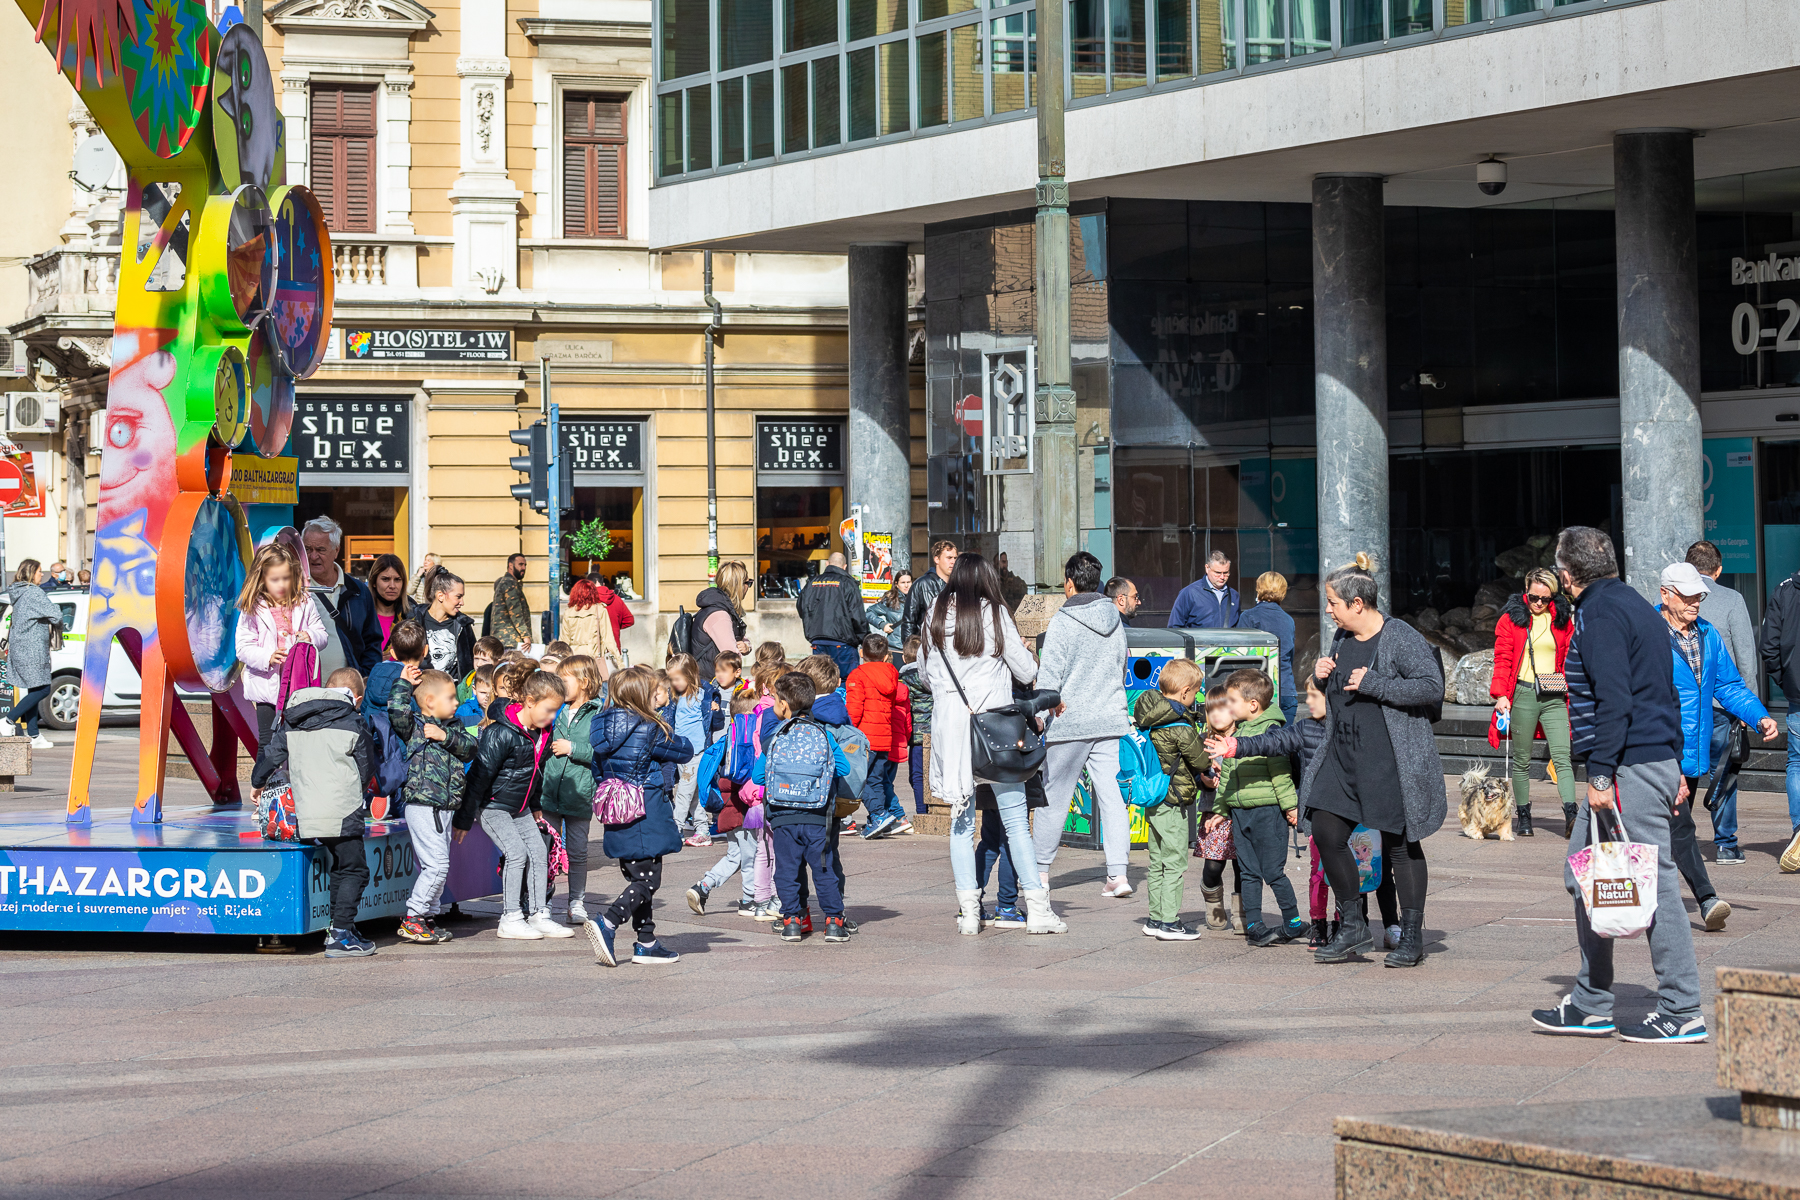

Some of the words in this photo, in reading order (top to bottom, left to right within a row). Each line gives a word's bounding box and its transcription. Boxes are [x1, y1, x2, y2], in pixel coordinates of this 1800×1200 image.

[373, 330, 467, 349] HO(S)TEL
[477, 332, 506, 348] 1W
[244, 469, 295, 484] BALTHAZARGRAD
[863, 531, 892, 544] Plesna
[0, 866, 266, 898] THAZARGRAD
[1595, 882, 1623, 890] Terra
[374, 893, 382, 906] OF
[383, 888, 409, 904] CULTURE
[1598, 890, 1633, 900] Naturi
[77, 902, 81, 913] i
[84, 904, 148, 914] suvremene
